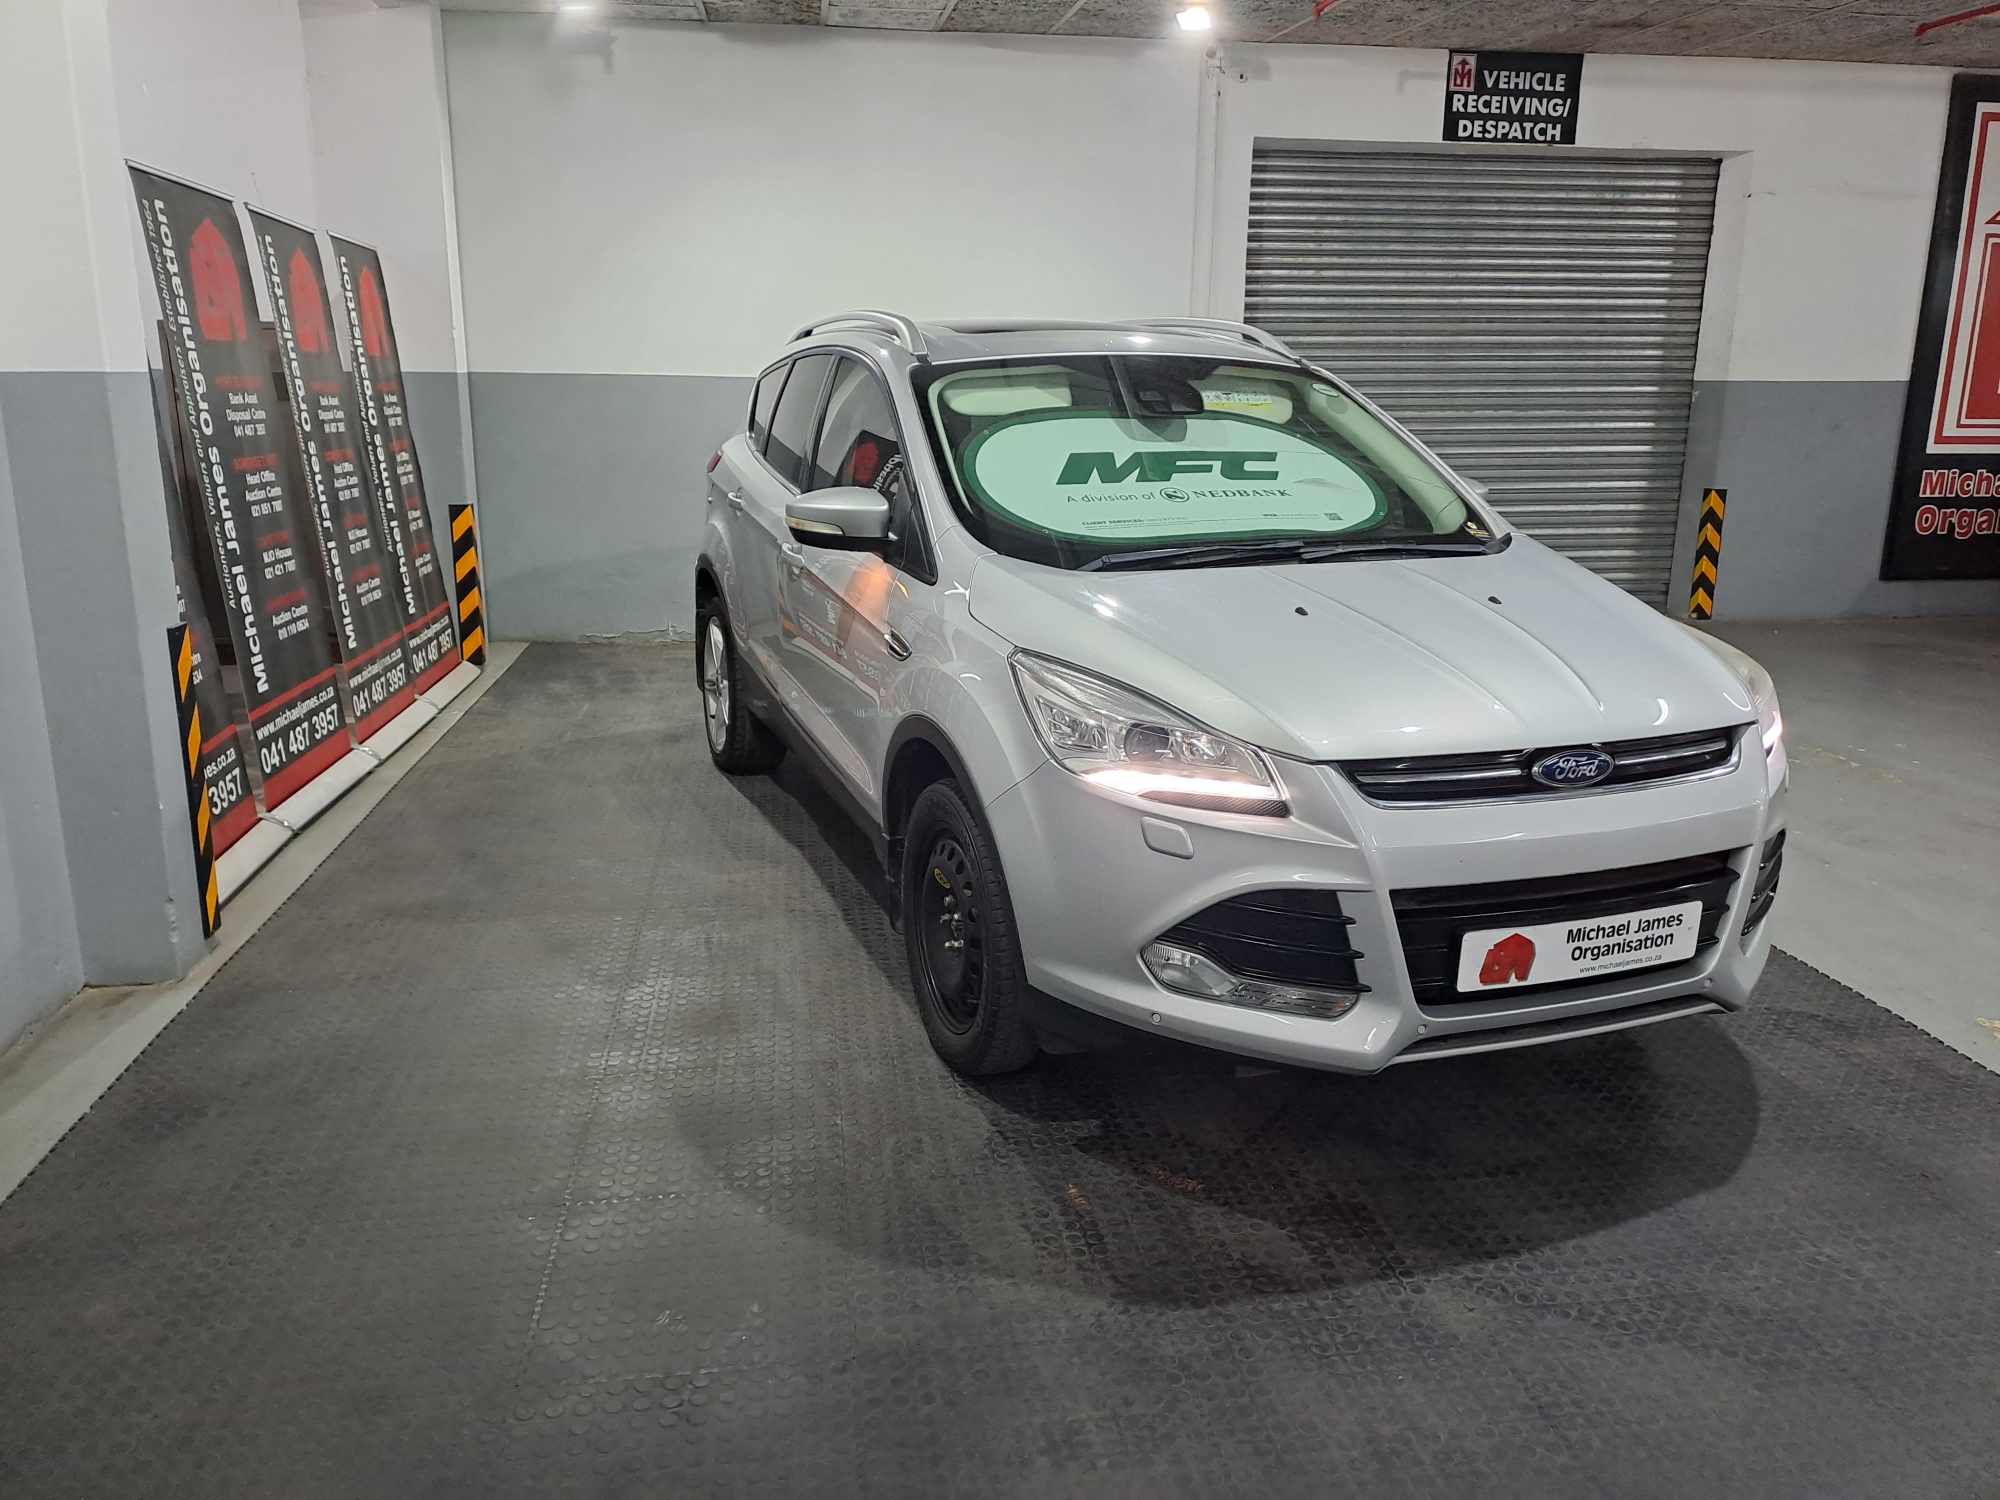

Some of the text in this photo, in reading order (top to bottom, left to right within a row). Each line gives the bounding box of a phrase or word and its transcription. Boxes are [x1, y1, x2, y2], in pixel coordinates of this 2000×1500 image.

[1483, 70, 1567, 92] VEHICLE
[1452, 94, 1571, 118] RECEIVING/
[1457, 119, 1562, 142] DESPATCH
[264, 234, 311, 432] Organisation
[339, 256, 378, 427] Organisation
[154, 199, 269, 694] Michael James Organisation
[307, 440, 333, 533] James
[374, 433, 396, 514] James
[1055, 450, 1280, 486] MFC
[1067, 488, 1294, 504] A division of NEDBANK
[1915, 504, 2000, 540] Orga
[390, 520, 416, 615] Michael
[327, 540, 358, 649] Michael
[412, 647, 429, 673] 041
[352, 662, 407, 717] 041 487 3957
[261, 703, 339, 774] 041 487 3957
[1553, 756, 1602, 779] Ford
[208, 767, 243, 815] 3957
[1566, 912, 1684, 944] Michael James
[1570, 931, 1674, 962] Organisation
